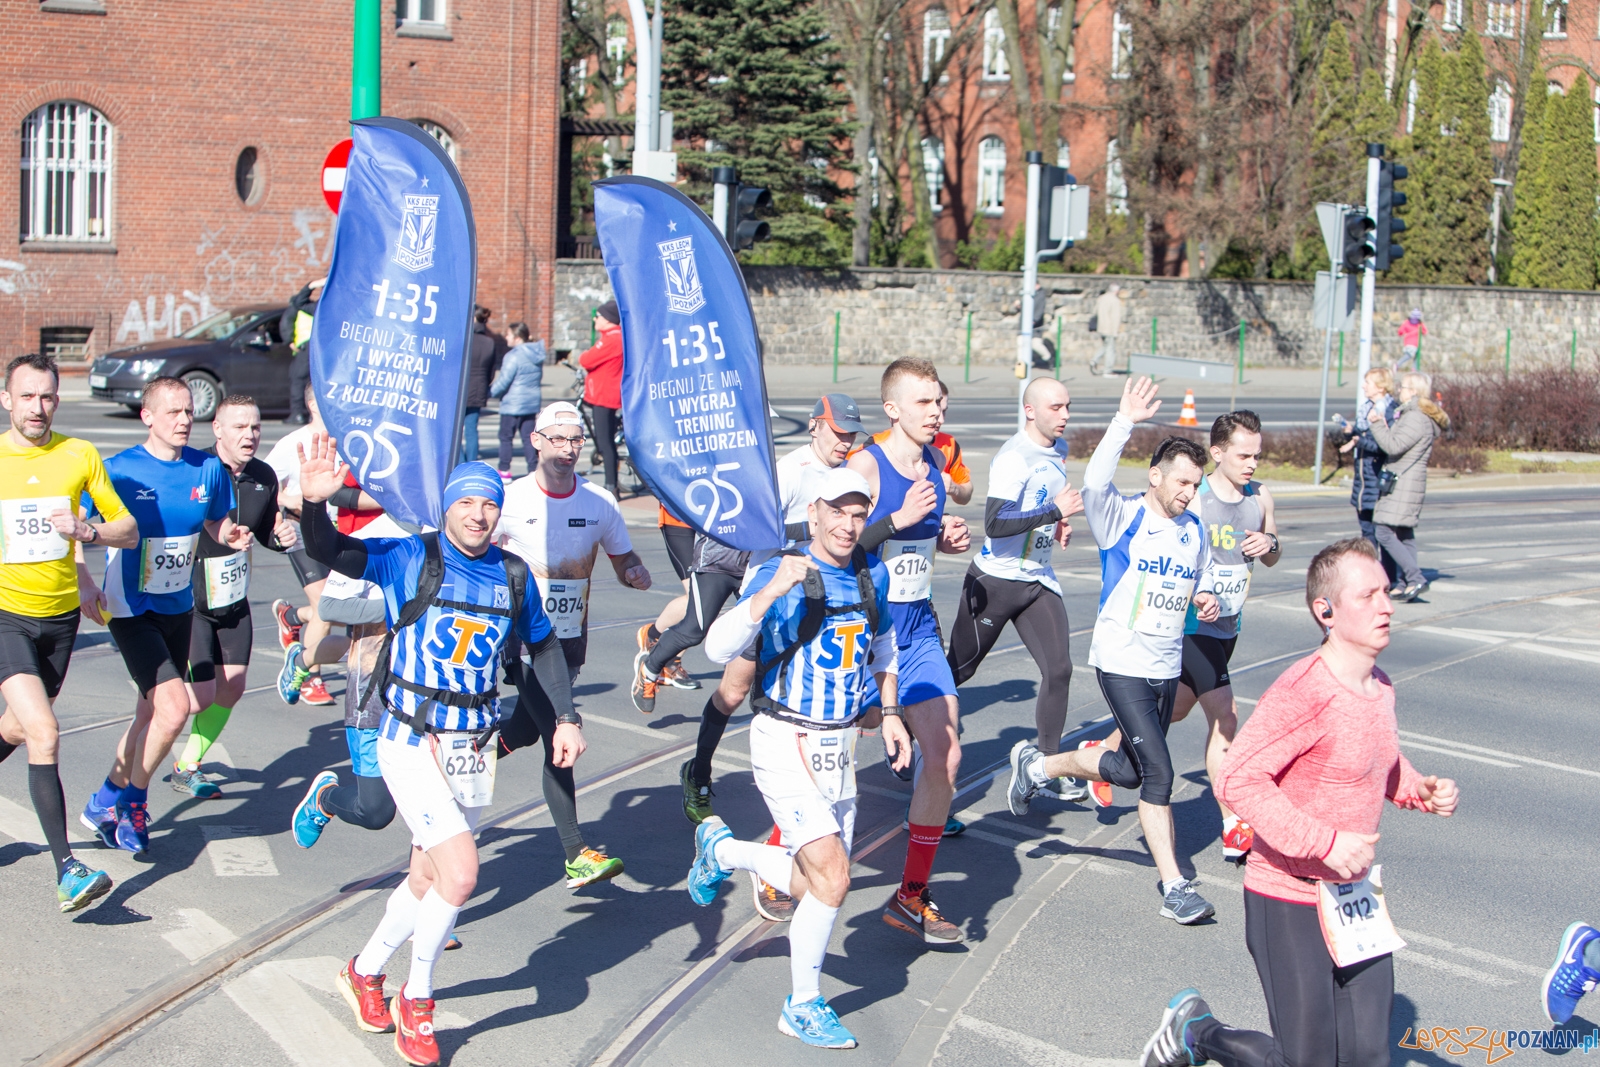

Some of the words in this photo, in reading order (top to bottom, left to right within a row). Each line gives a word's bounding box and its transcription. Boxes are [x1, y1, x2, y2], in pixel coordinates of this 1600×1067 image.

[407, 197, 420, 206] KKS
[421, 197, 437, 206] LECH
[661, 243, 675, 253] KKS
[676, 240, 690, 250] LECH
[372, 279, 439, 325] 1:35
[340, 321, 395, 349] BIEGNIJ
[399, 333, 418, 352] ZE
[421, 336, 446, 360] MNĄ
[662, 321, 726, 368] 1:35
[356, 346, 363, 363] I
[369, 348, 431, 376] WYGRAJ
[357, 366, 424, 395] TRENING
[650, 377, 694, 400] BIEGNIJ
[700, 373, 714, 391] ZE
[327, 382, 338, 399] Z
[342, 384, 438, 420] KOLEJORZEM
[669, 400, 675, 417] I
[679, 391, 736, 416] WYGRAJ
[350, 417, 373, 428] 1922
[675, 412, 735, 437] TRENING
[343, 421, 413, 486] 95
[655, 443, 665, 459] Z
[671, 430, 758, 458] KOLEJORZEM
[685, 467, 707, 477] 1922
[684, 462, 743, 533] 95
[717, 525, 737, 534] 2017
[1210, 523, 1236, 550] 16
[155, 551, 192, 570] 9308
[894, 557, 927, 575] 6114
[221, 562, 248, 585] 5519
[1213, 578, 1248, 596] 0467
[543, 597, 584, 614] 0874
[1147, 591, 1188, 612] 10682
[421, 613, 502, 671] STS
[445, 754, 486, 776] 6226
[811, 749, 850, 772] 8504
[1334, 897, 1375, 926] 1912
